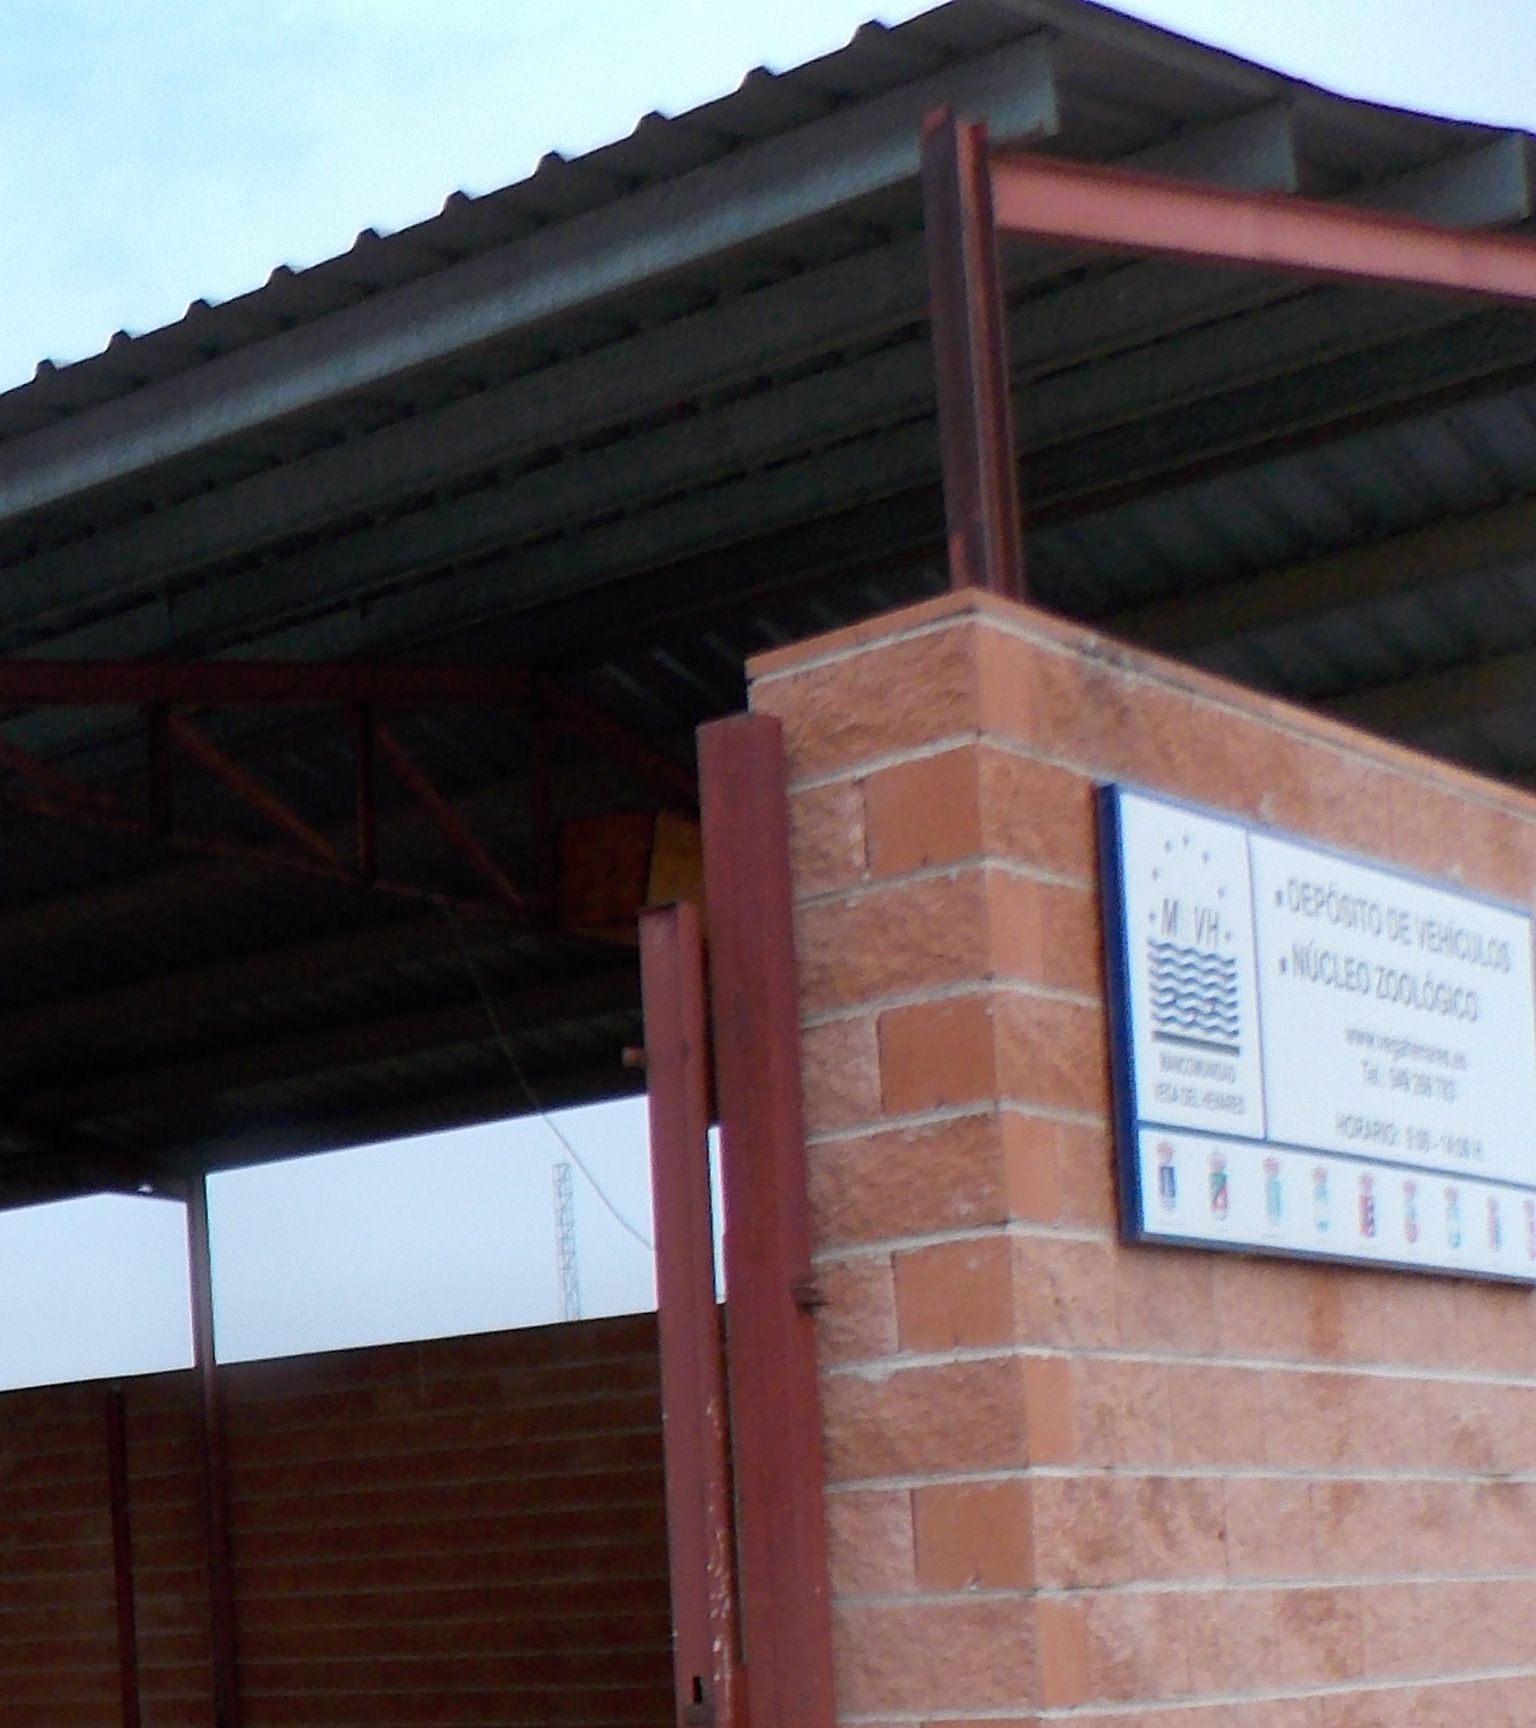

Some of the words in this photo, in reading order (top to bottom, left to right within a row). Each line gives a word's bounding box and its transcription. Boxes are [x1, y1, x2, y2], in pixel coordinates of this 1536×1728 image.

[1286, 877, 1382, 938] DEPÓSITO
[1385, 906, 1413, 946] DE
[1414, 914, 1511, 974] VEHÍCULOS
[1290, 939, 1370, 995] NÚCLEO
[1374, 964, 1479, 1023] ZOOLÓGICO
